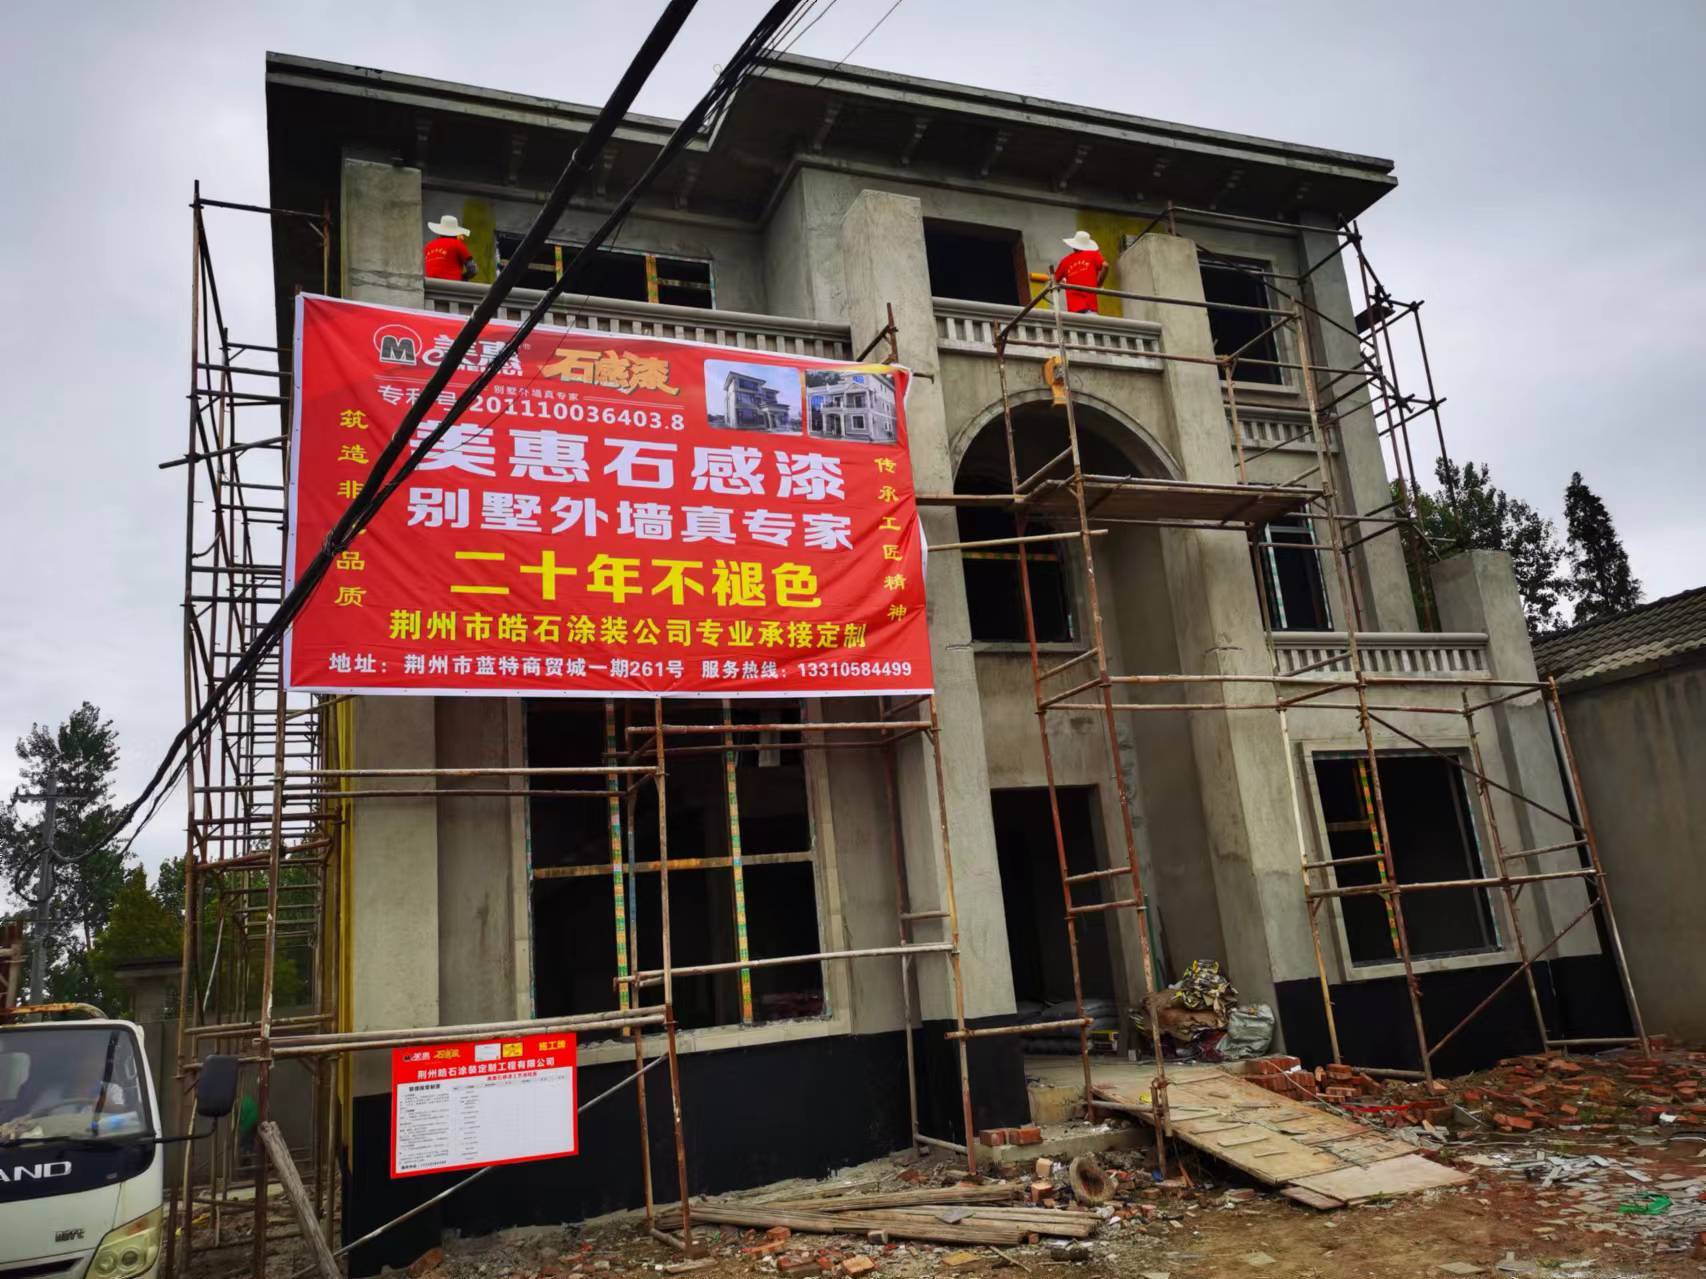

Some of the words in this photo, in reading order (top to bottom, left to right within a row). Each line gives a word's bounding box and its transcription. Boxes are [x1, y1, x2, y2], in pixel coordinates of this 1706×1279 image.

[470, 394, 686, 431] 201110036403.8
[409, 420, 845, 500] 美惠石感漆
[335, 408, 369, 608] 筑造非品质
[407, 487, 853, 550] 别墅外墙真专家
[874, 457, 908, 622] 传承工匠精神
[450, 550, 822, 608] 二十年不褪色
[389, 609, 867, 648] 荆州市皓石涂装公司专业承接定制
